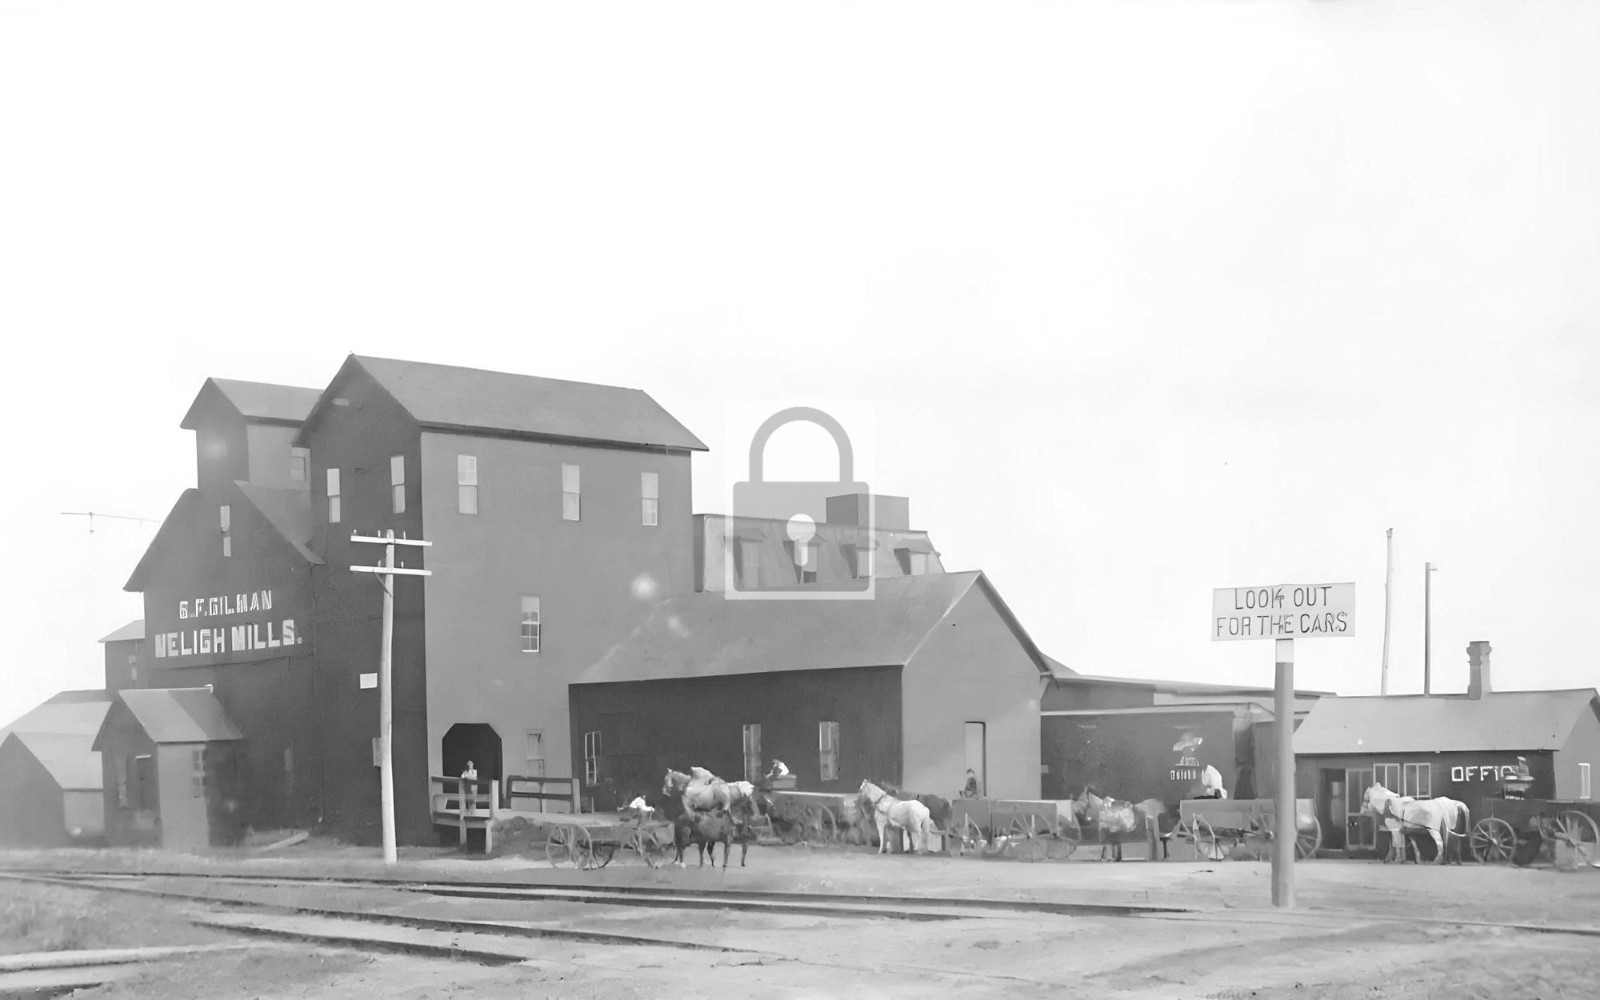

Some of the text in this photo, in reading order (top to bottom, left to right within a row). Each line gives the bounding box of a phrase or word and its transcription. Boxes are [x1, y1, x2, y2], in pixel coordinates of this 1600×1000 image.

[1235, 586, 1332, 610] LOOK OUT
[1217, 611, 1348, 637] FOR THE CARS
[1451, 765, 1519, 781] OFFIC
